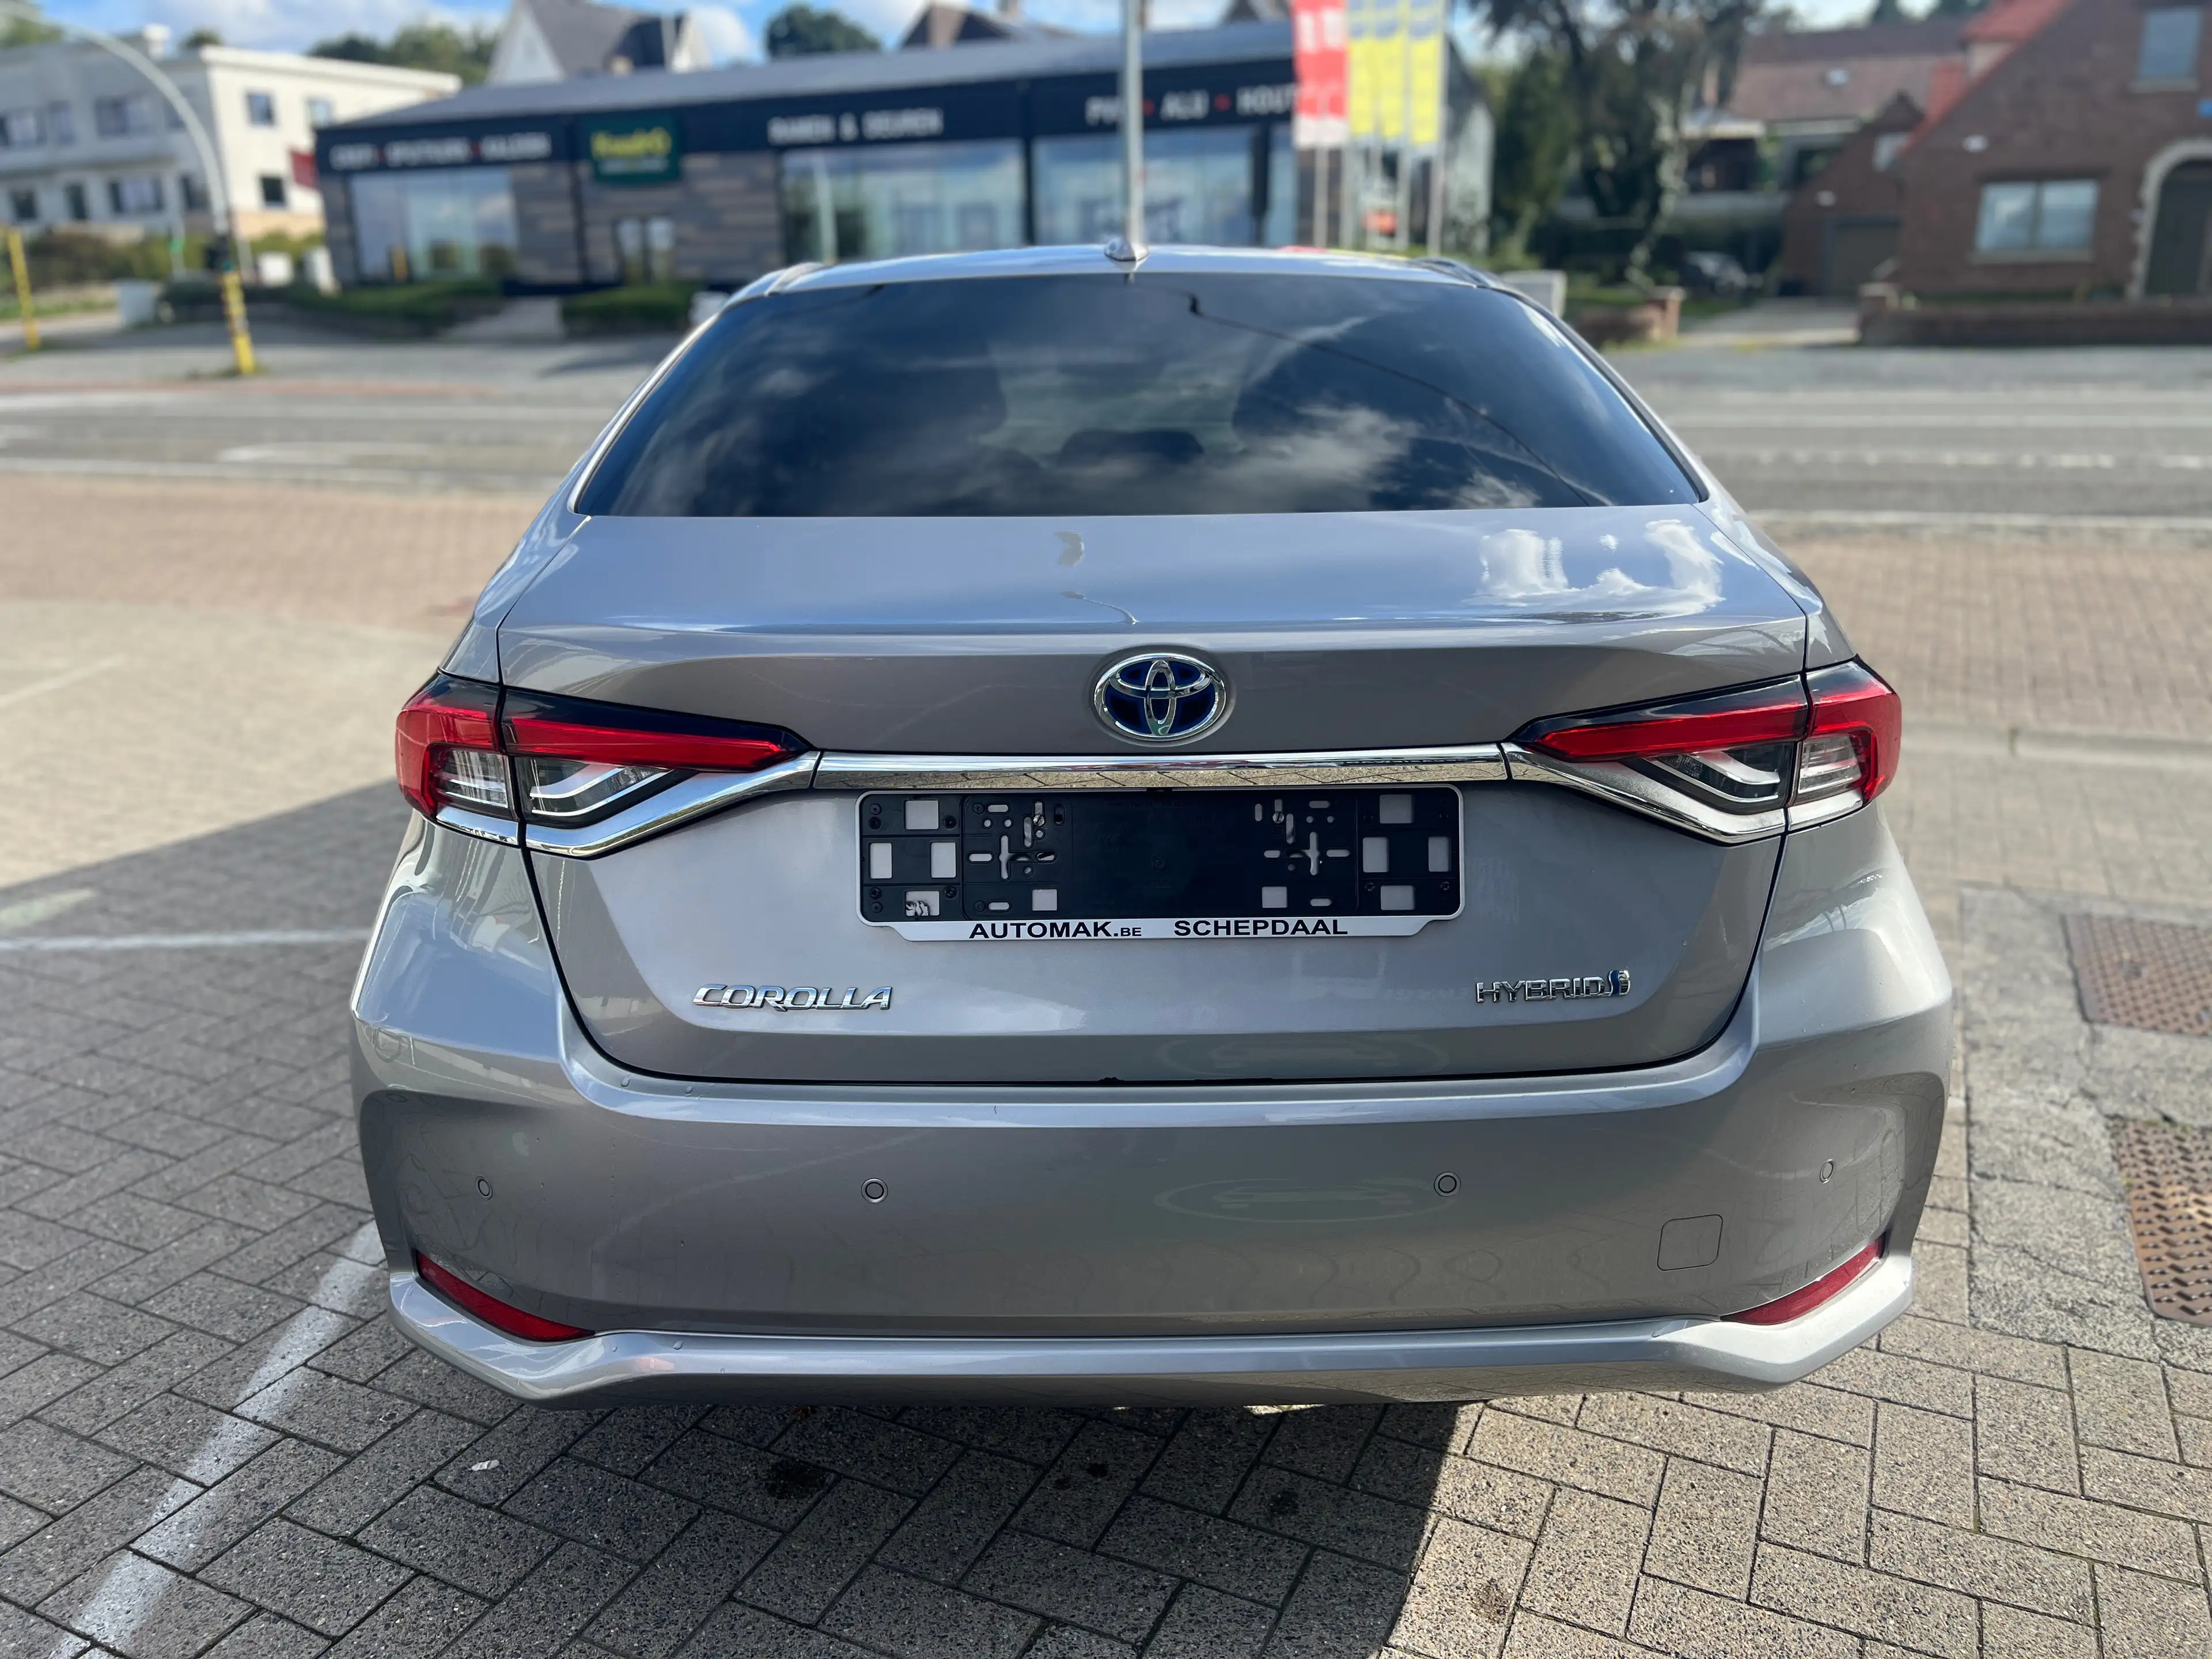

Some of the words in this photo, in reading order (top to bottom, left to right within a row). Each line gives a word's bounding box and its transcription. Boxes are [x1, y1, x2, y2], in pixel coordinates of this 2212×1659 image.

[969, 921, 1142, 939] AUTOMAK.BE
[1173, 919, 1348, 937] SCHEPDAAL
[693, 983, 893, 1012] COROLLA
[1476, 976, 1605, 1003] HYBRID
